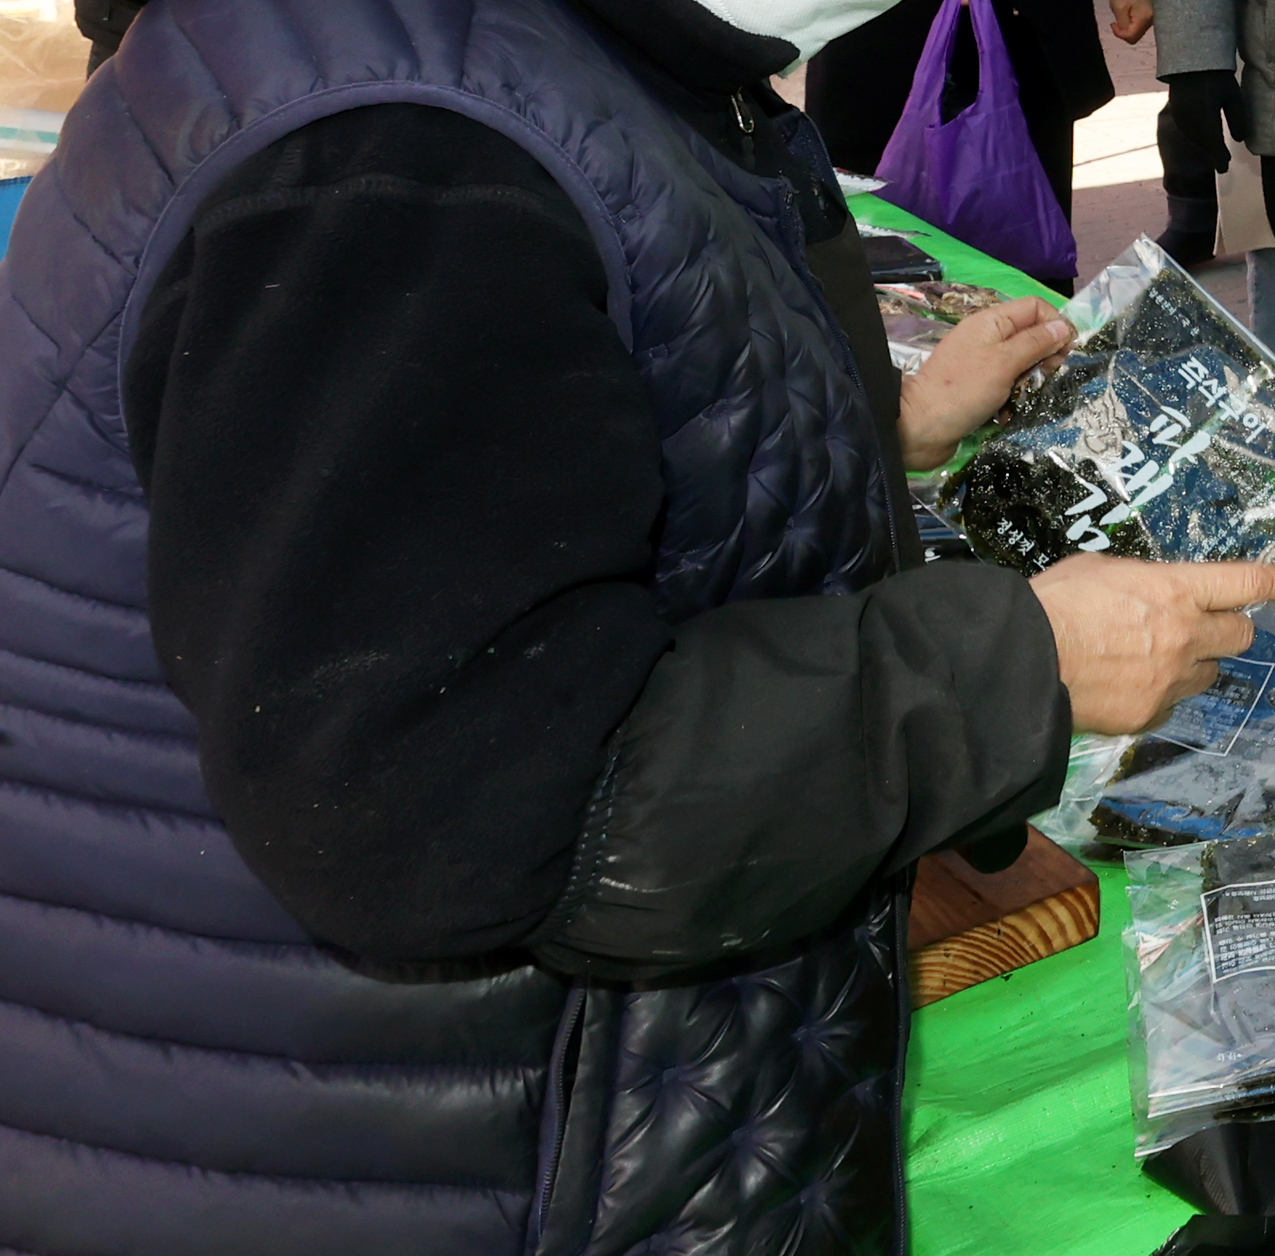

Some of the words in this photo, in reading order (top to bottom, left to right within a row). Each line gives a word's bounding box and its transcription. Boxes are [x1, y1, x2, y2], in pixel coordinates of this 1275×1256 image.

[1178, 357, 1269, 442] 즉석구이
[1065, 405, 1212, 552] 파래김
[996, 518, 1035, 556] 정성껏
